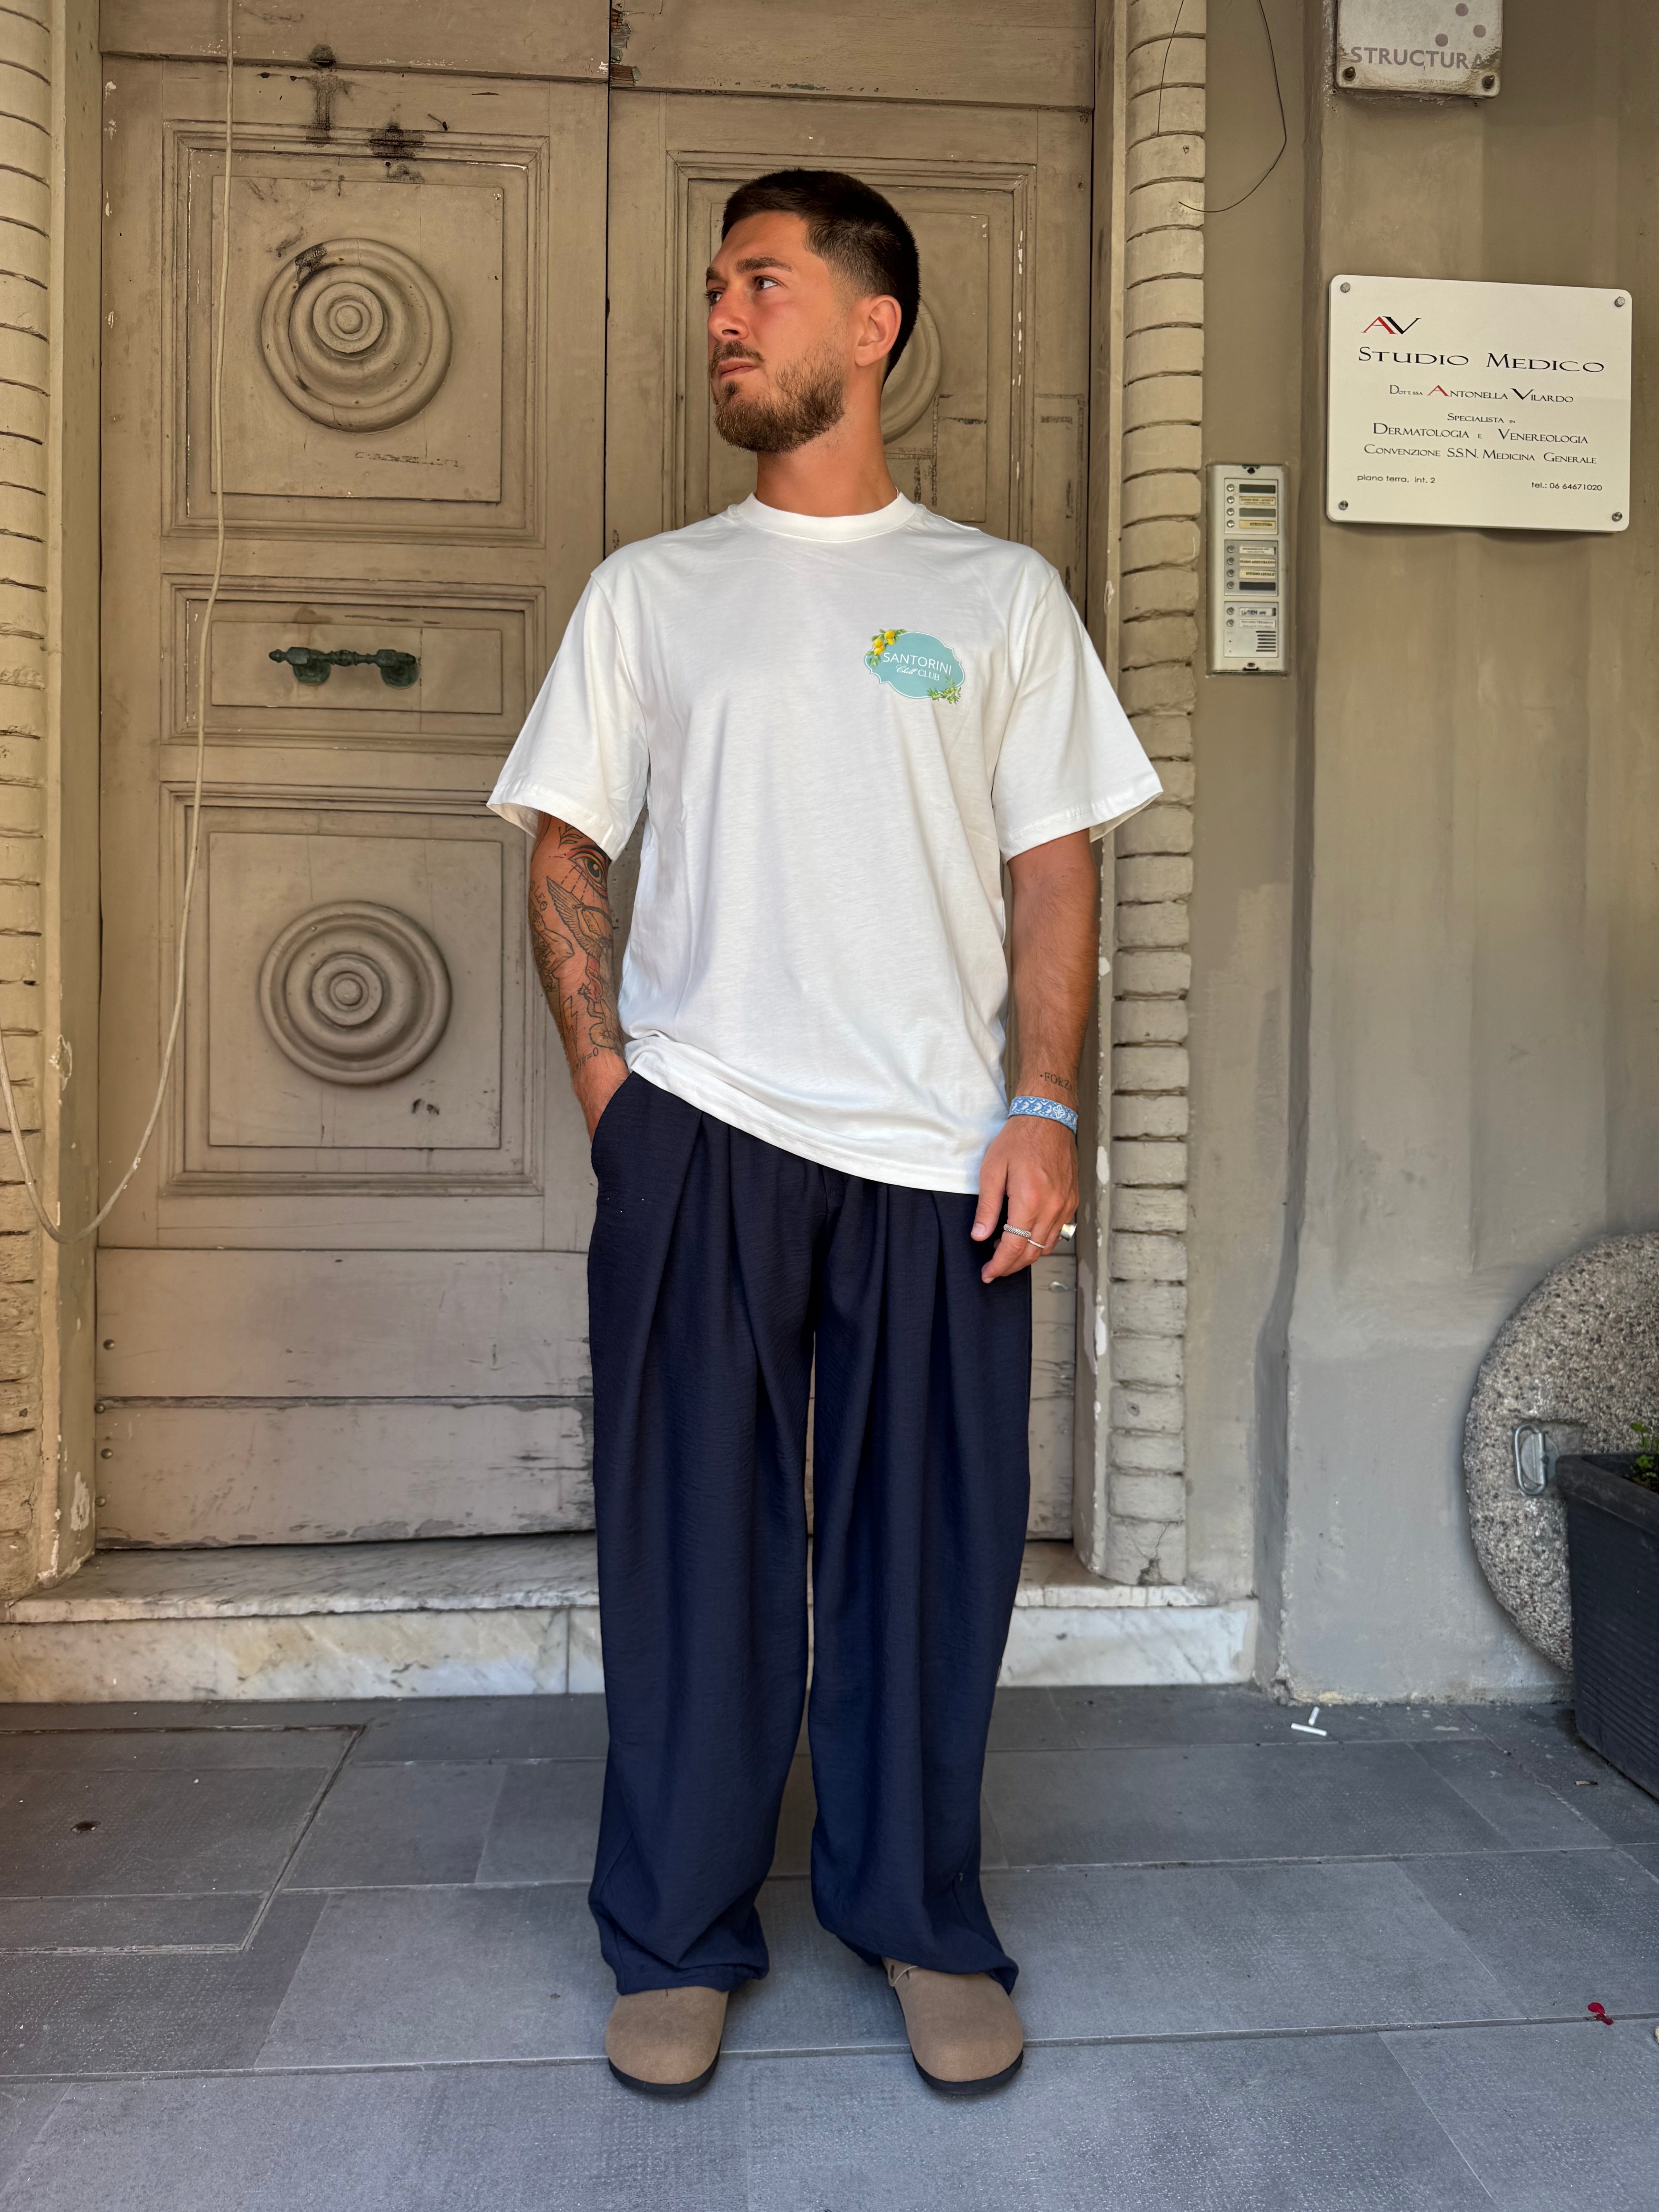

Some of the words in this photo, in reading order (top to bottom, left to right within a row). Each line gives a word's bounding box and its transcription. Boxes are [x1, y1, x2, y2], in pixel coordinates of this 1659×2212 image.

[1350, 46, 1482, 69] STRUCTURA
[1360, 316, 1422, 335] AV
[1358, 347, 1469, 366] STUDIO
[1486, 353, 1604, 372] MEDICO
[1427, 385, 1508, 399] ANTONELLA
[1510, 388, 1573, 402] VILARDO
[1447, 413, 1504, 423] SPECIALISTA
[1373, 422, 1469, 438] DERMATOLOGIA
[1498, 428, 1588, 444] VENEREOLOGIA
[1364, 444, 1441, 457] CONVENZIONE
[1483, 449, 1535, 461] MEDICINA
[1544, 452, 1597, 464] GENERALE
[883, 652, 952, 675] SANTORINI
[896, 665, 918, 675] Chill
[917, 669, 940, 681] CLUB
